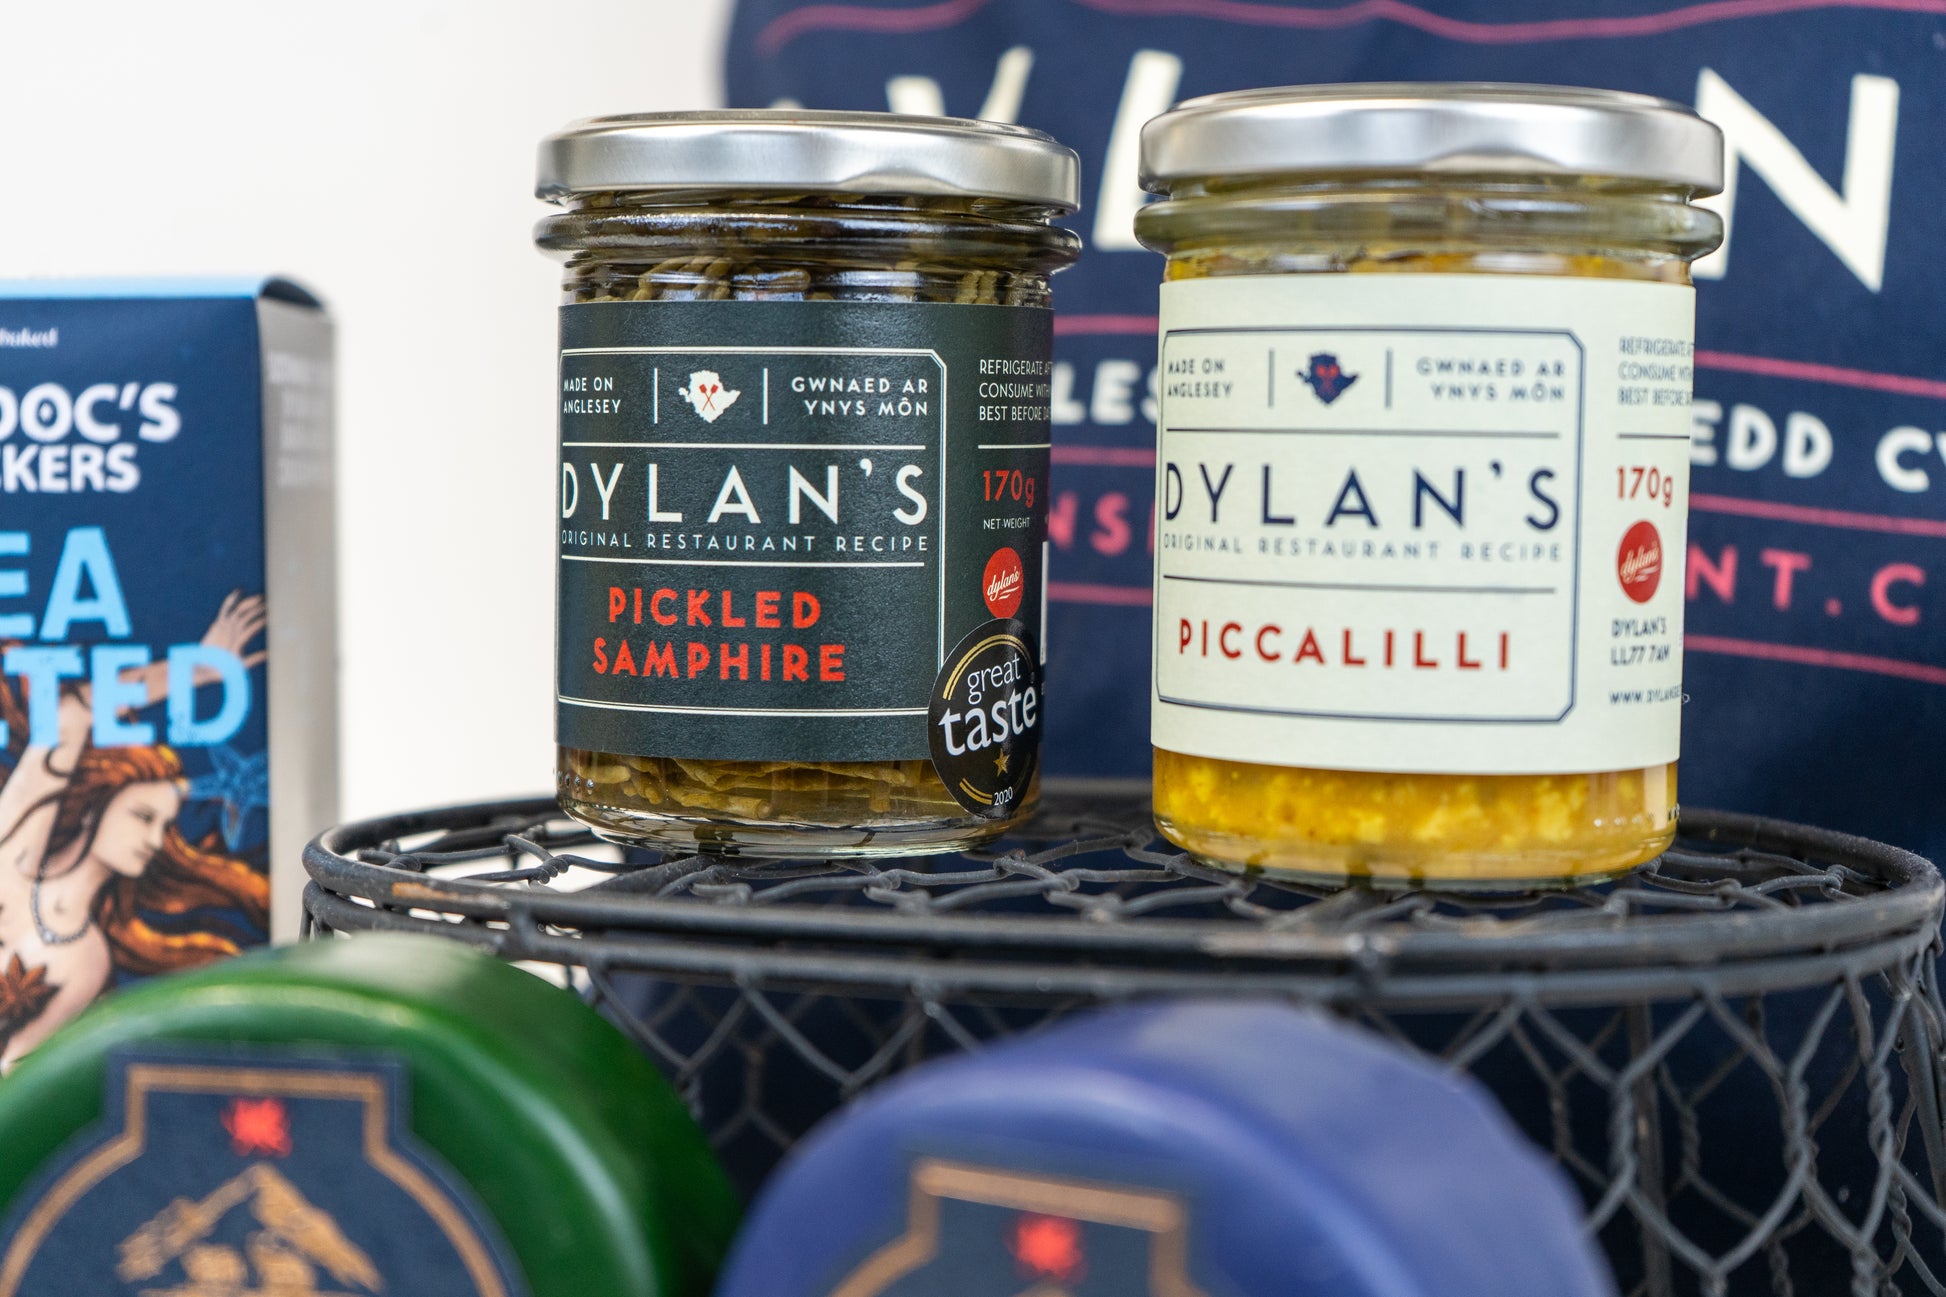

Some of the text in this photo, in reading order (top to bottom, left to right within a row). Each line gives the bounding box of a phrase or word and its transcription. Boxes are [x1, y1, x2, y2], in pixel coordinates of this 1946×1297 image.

[979, 359, 1043, 376] REFRIGERATE
[1167, 359, 1195, 375] MADE
[1537, 360, 1566, 377] AR
[563, 376, 613, 392] MADE ON
[791, 376, 929, 394] GWNAED AR
[979, 382, 1034, 398] CONSUME
[1167, 382, 1234, 399] ANGLESEY
[563, 399, 622, 414] ANGLESEY
[804, 397, 929, 416] YNYS MÔN
[979, 405, 1008, 421] BEST
[1011, 406, 1042, 421] BEFORE
[1, 442, 140, 493] KERS
[562, 458, 928, 526] DYLAN'S
[983, 469, 1035, 508] 170g
[1166, 459, 1560, 531] DYLAN'S
[1617, 466, 1674, 508] 170g
[983, 516, 1030, 530] NET WEIGHT
[561, 530, 928, 551] ORIGINAL RESTAURANT RECIPE
[1163, 532, 1562, 563] ORIGINAL RESTAURANT RECIPE
[608, 586, 822, 629] PICKLED
[1612, 616, 1667, 637] DYLAN'S
[1178, 617, 1511, 671] PICCALILLI
[592, 637, 846, 682] SAMPHIRE
[967, 652, 1021, 705] great
[0, 643, 252, 748] TED
[938, 685, 1037, 756] taste
[994, 786, 1014, 806] 2020
